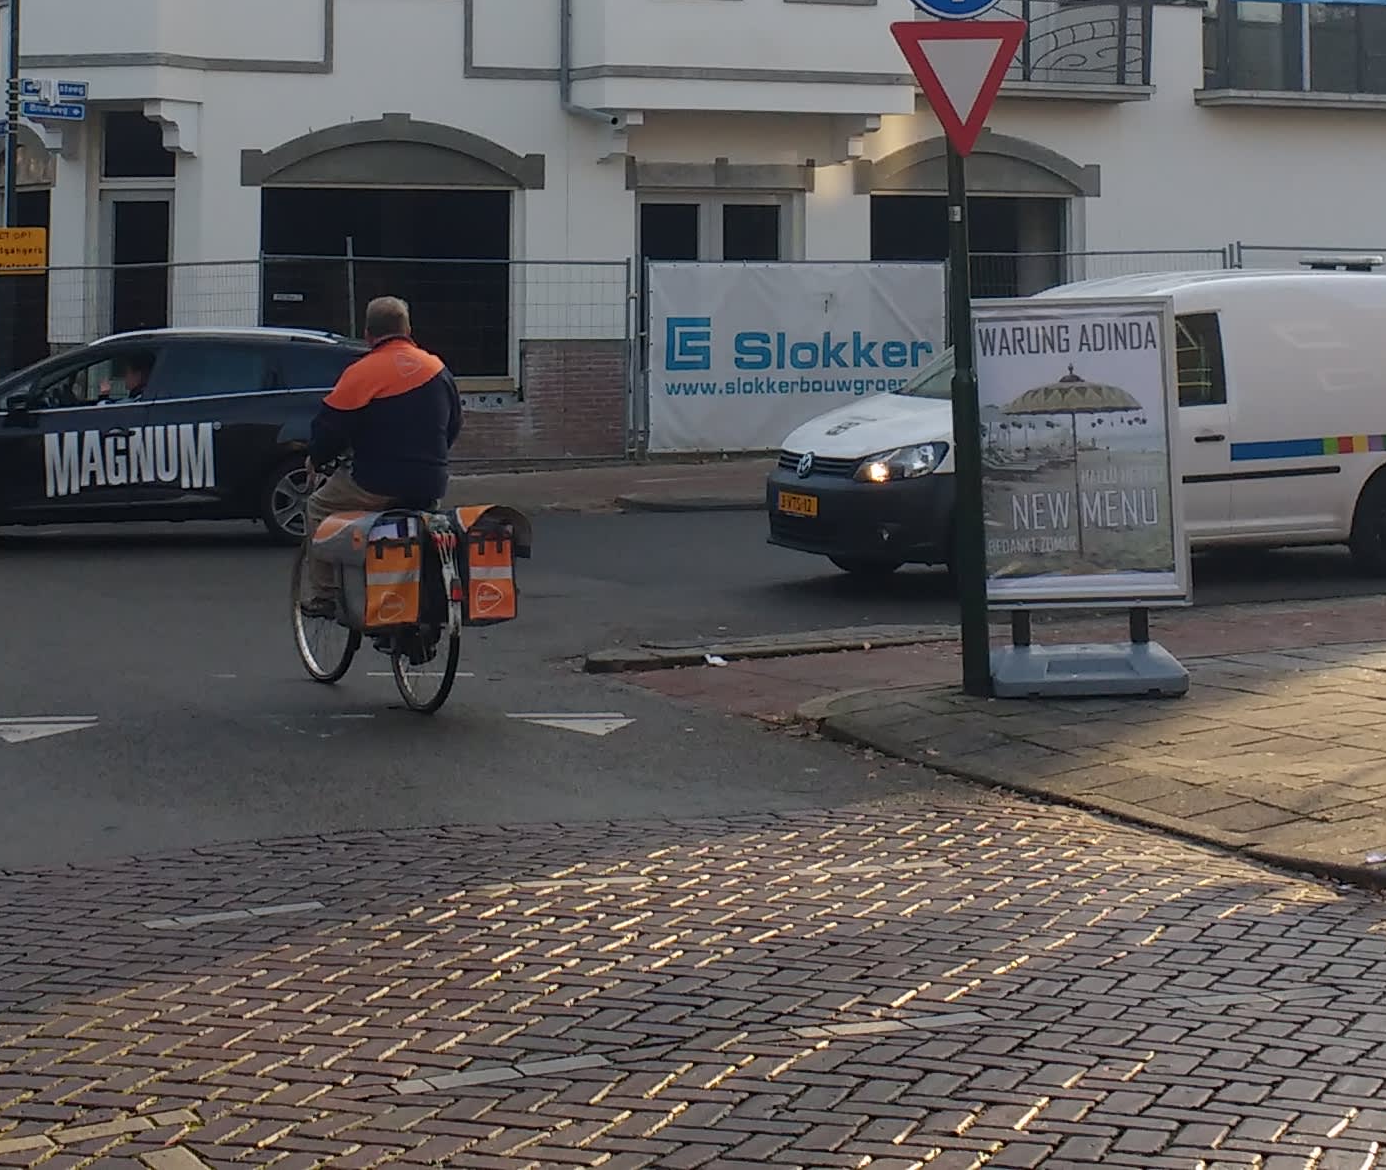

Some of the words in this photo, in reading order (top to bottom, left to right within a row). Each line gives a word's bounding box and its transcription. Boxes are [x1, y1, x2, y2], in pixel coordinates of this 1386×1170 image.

[734, 331, 933, 370] Slokker
[978, 324, 1070, 357] WARUNG
[1078, 321, 1157, 352] ADINDA
[44, 421, 215, 498] MAGNUM
[1012, 491, 1070, 530] NEW
[1082, 488, 1158, 527] MENU
